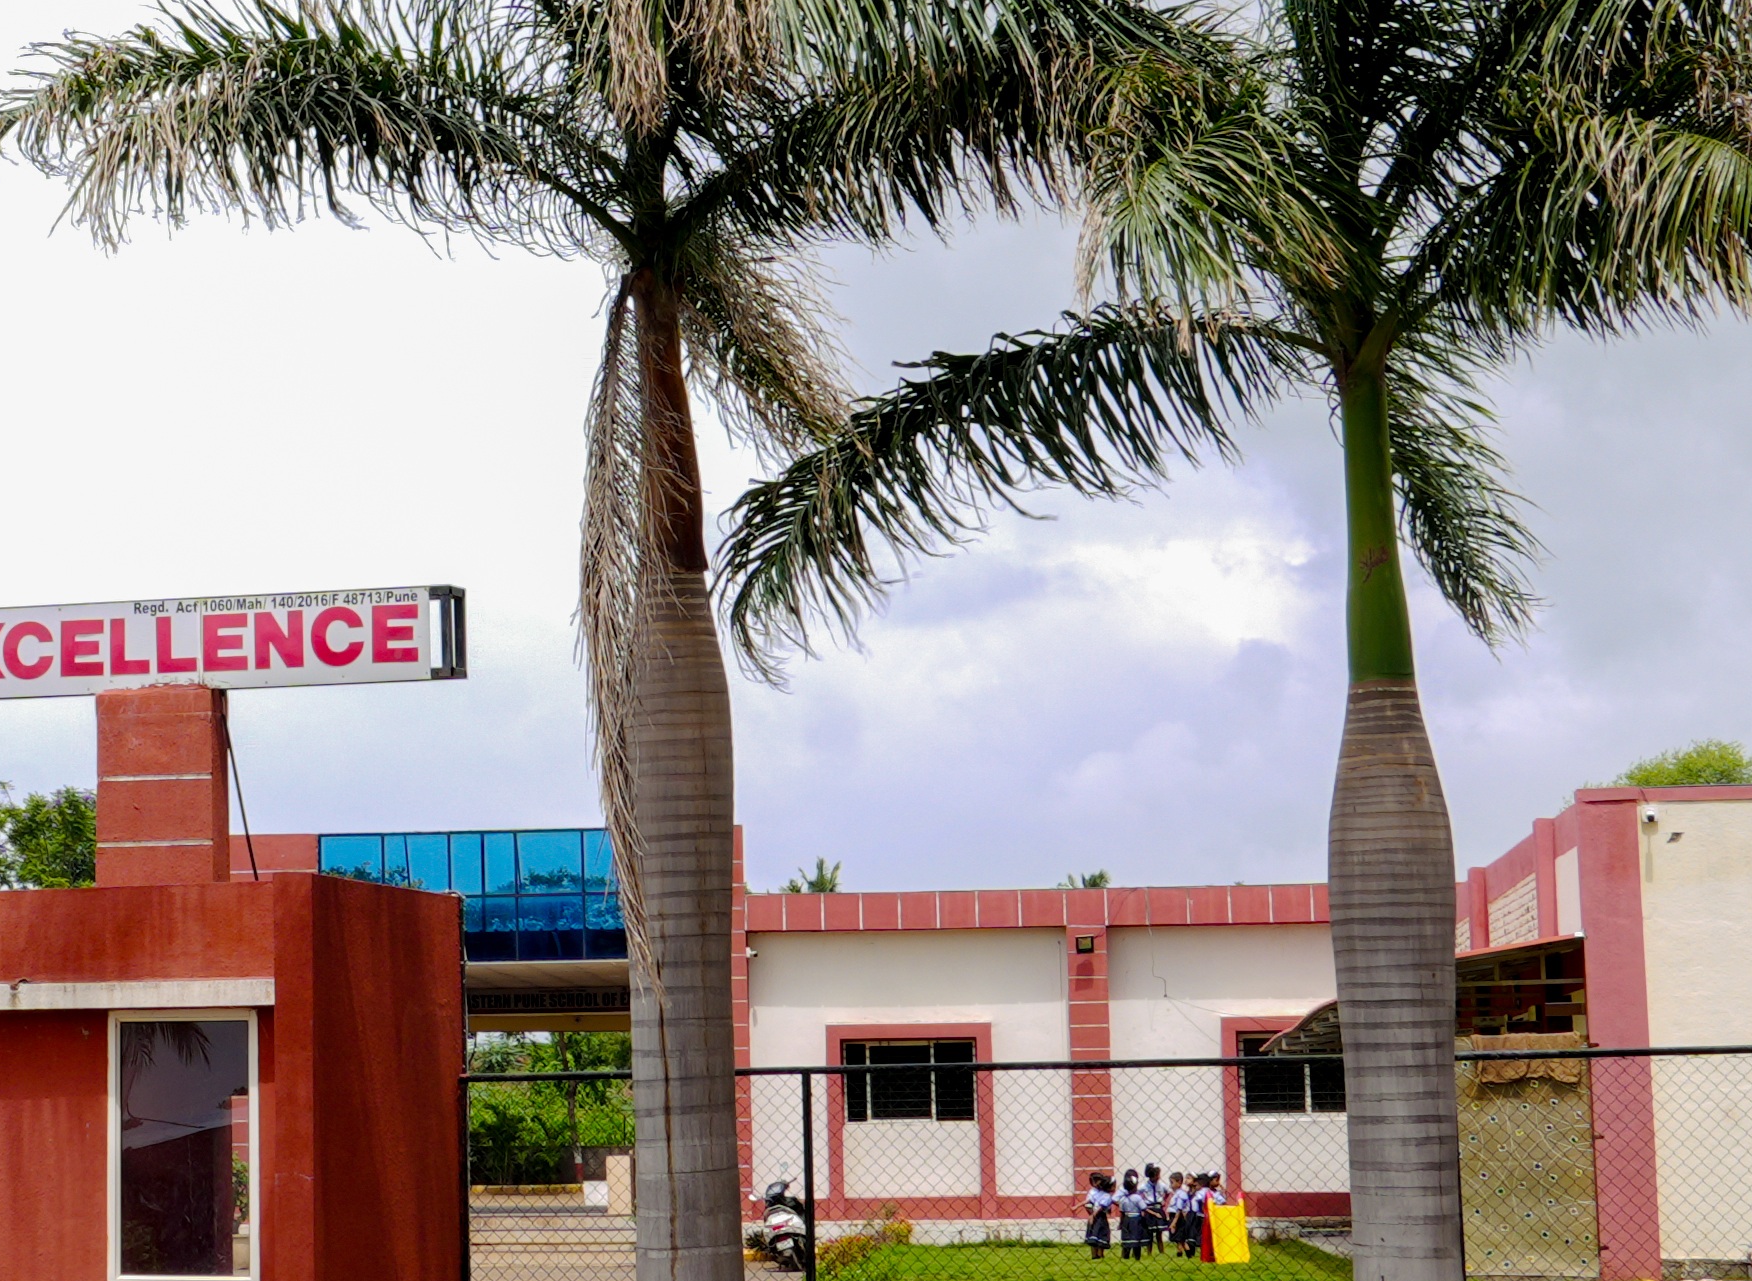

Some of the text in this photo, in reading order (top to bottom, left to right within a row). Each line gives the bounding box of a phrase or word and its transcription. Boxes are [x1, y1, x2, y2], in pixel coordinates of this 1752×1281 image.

[134, 601, 169, 616] Regd.
[343, 591, 418, 605] 48713/Pune
[468, 994, 511, 1008] STERN
[549, 992, 599, 1007] SCHOOL
[602, 991, 618, 1006] OF
